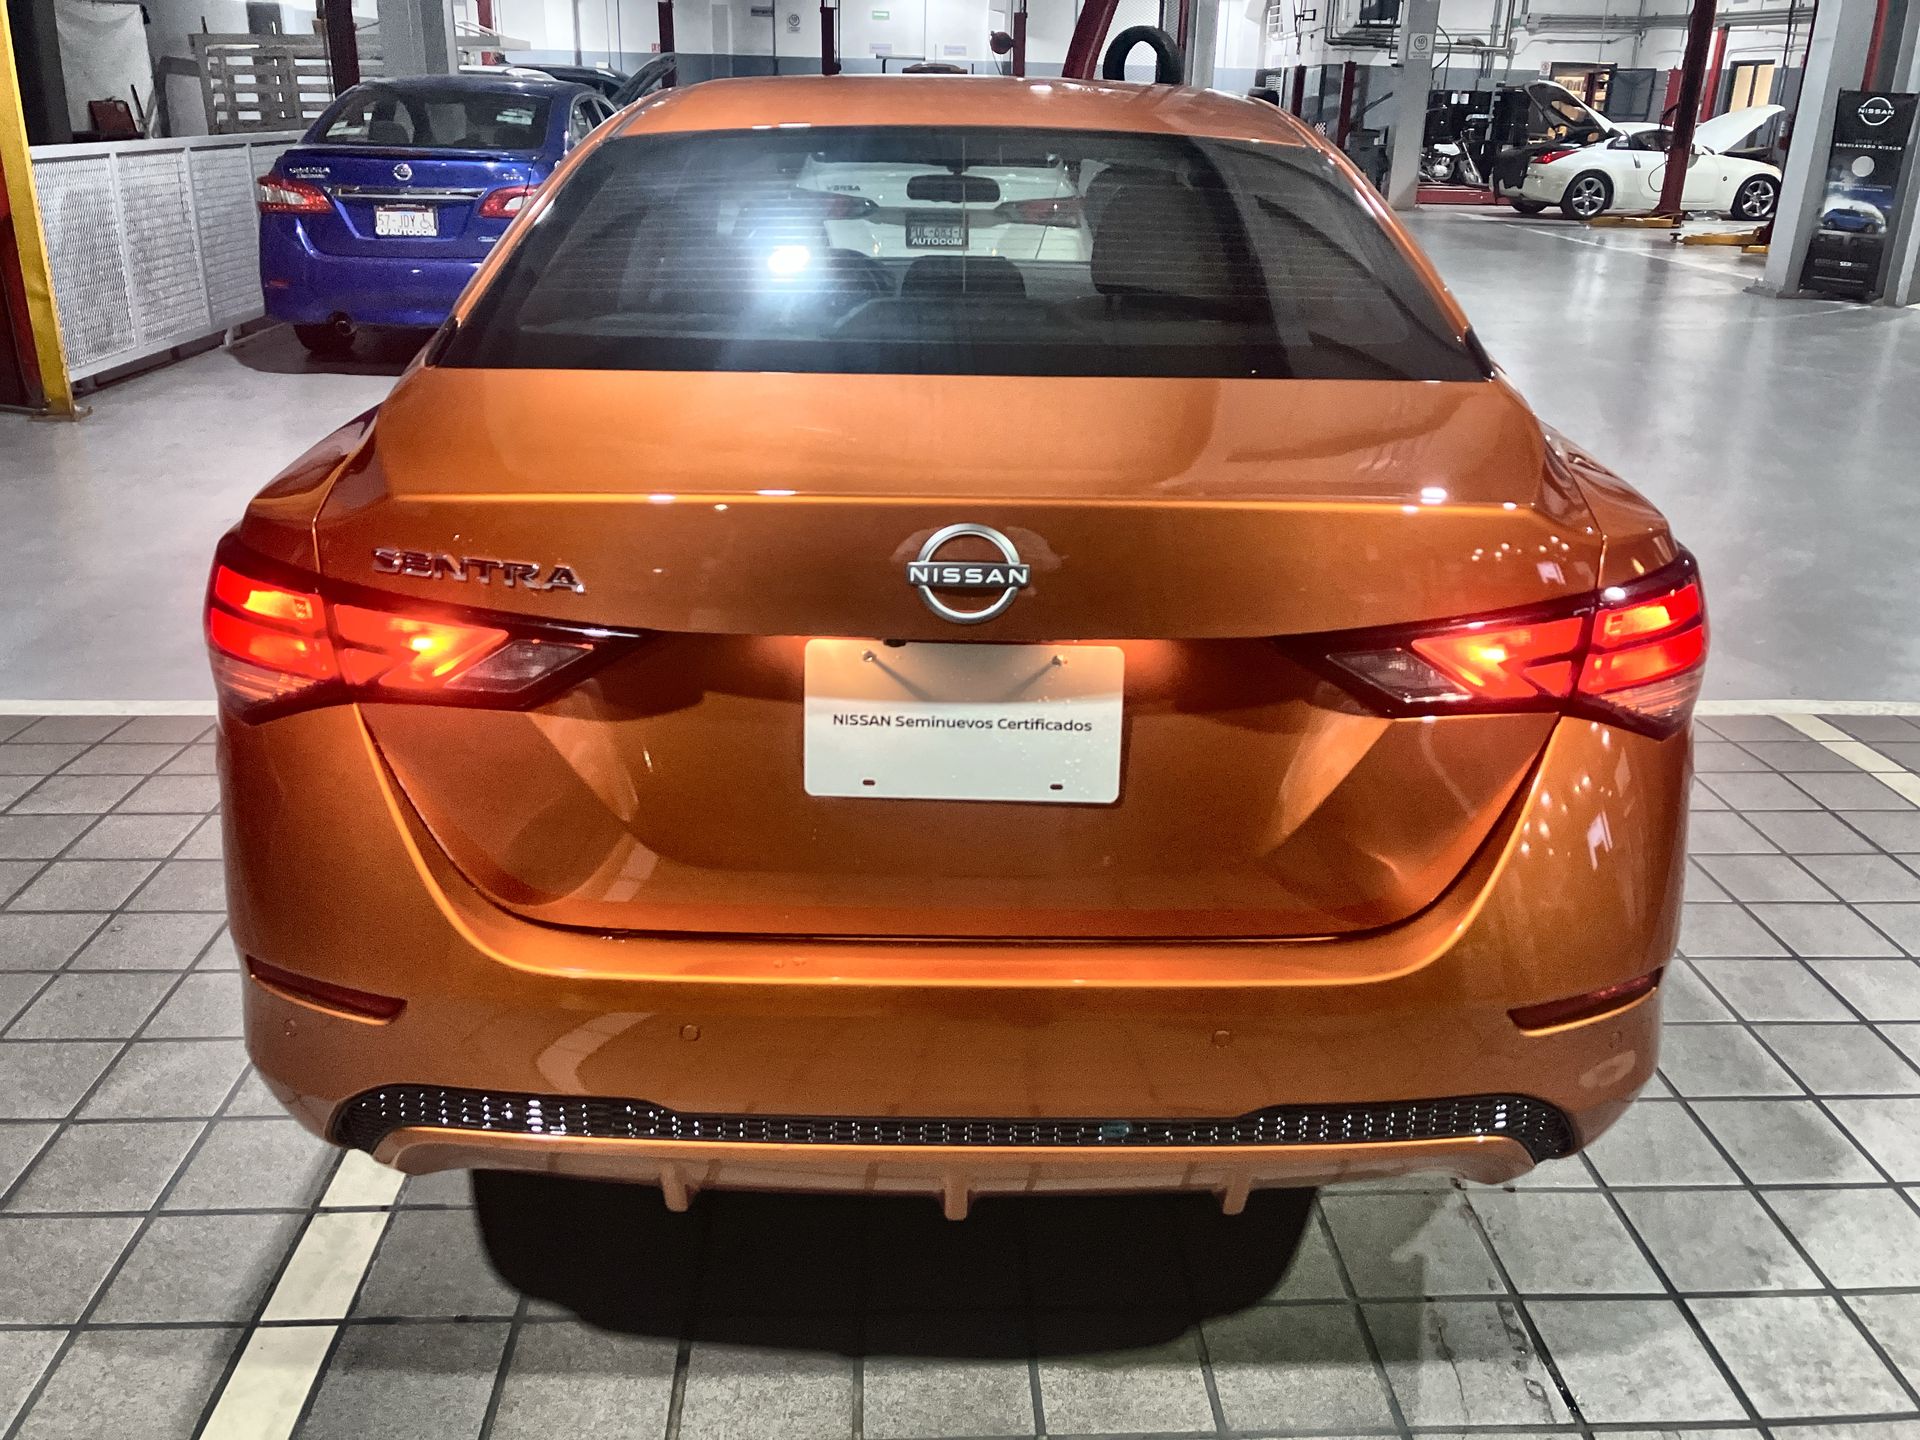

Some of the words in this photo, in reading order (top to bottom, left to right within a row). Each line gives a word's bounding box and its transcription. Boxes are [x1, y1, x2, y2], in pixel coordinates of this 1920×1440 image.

[1858, 107, 1895, 115] NISSAN
[911, 237, 963, 246] AUTOCOM
[372, 547, 586, 593] SENTRA
[909, 566, 1028, 584] NISSAN
[833, 714, 892, 727] NISSAN
[895, 715, 993, 730] Seminuevos
[997, 717, 1093, 732] Certificados
